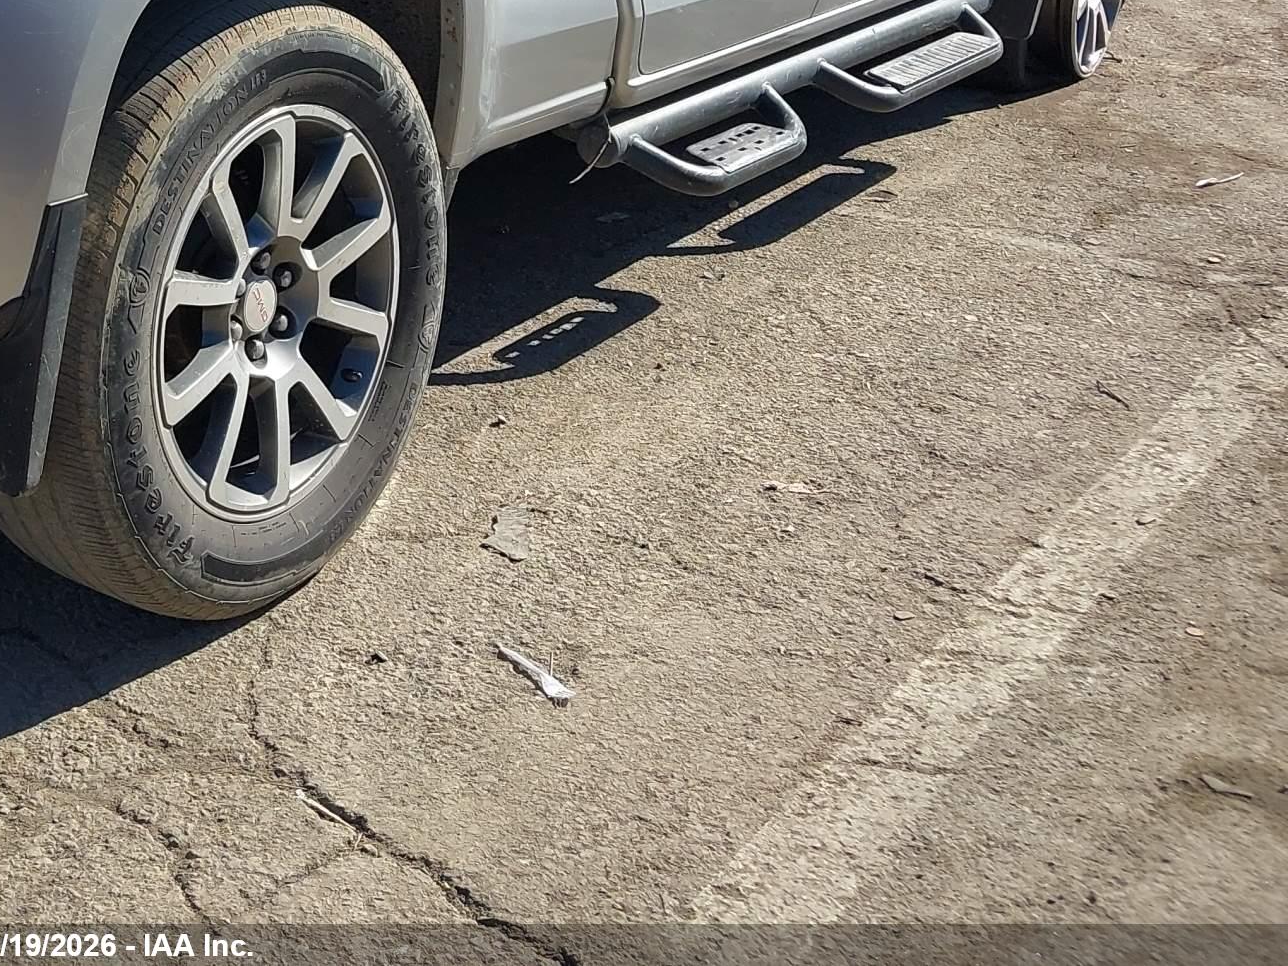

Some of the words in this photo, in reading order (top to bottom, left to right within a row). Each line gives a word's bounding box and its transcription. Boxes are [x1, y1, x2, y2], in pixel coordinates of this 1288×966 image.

[152, 84, 250, 235] DESTINATION
[252, 287, 269, 323] GMC
[123, 347, 195, 566] Firestone
